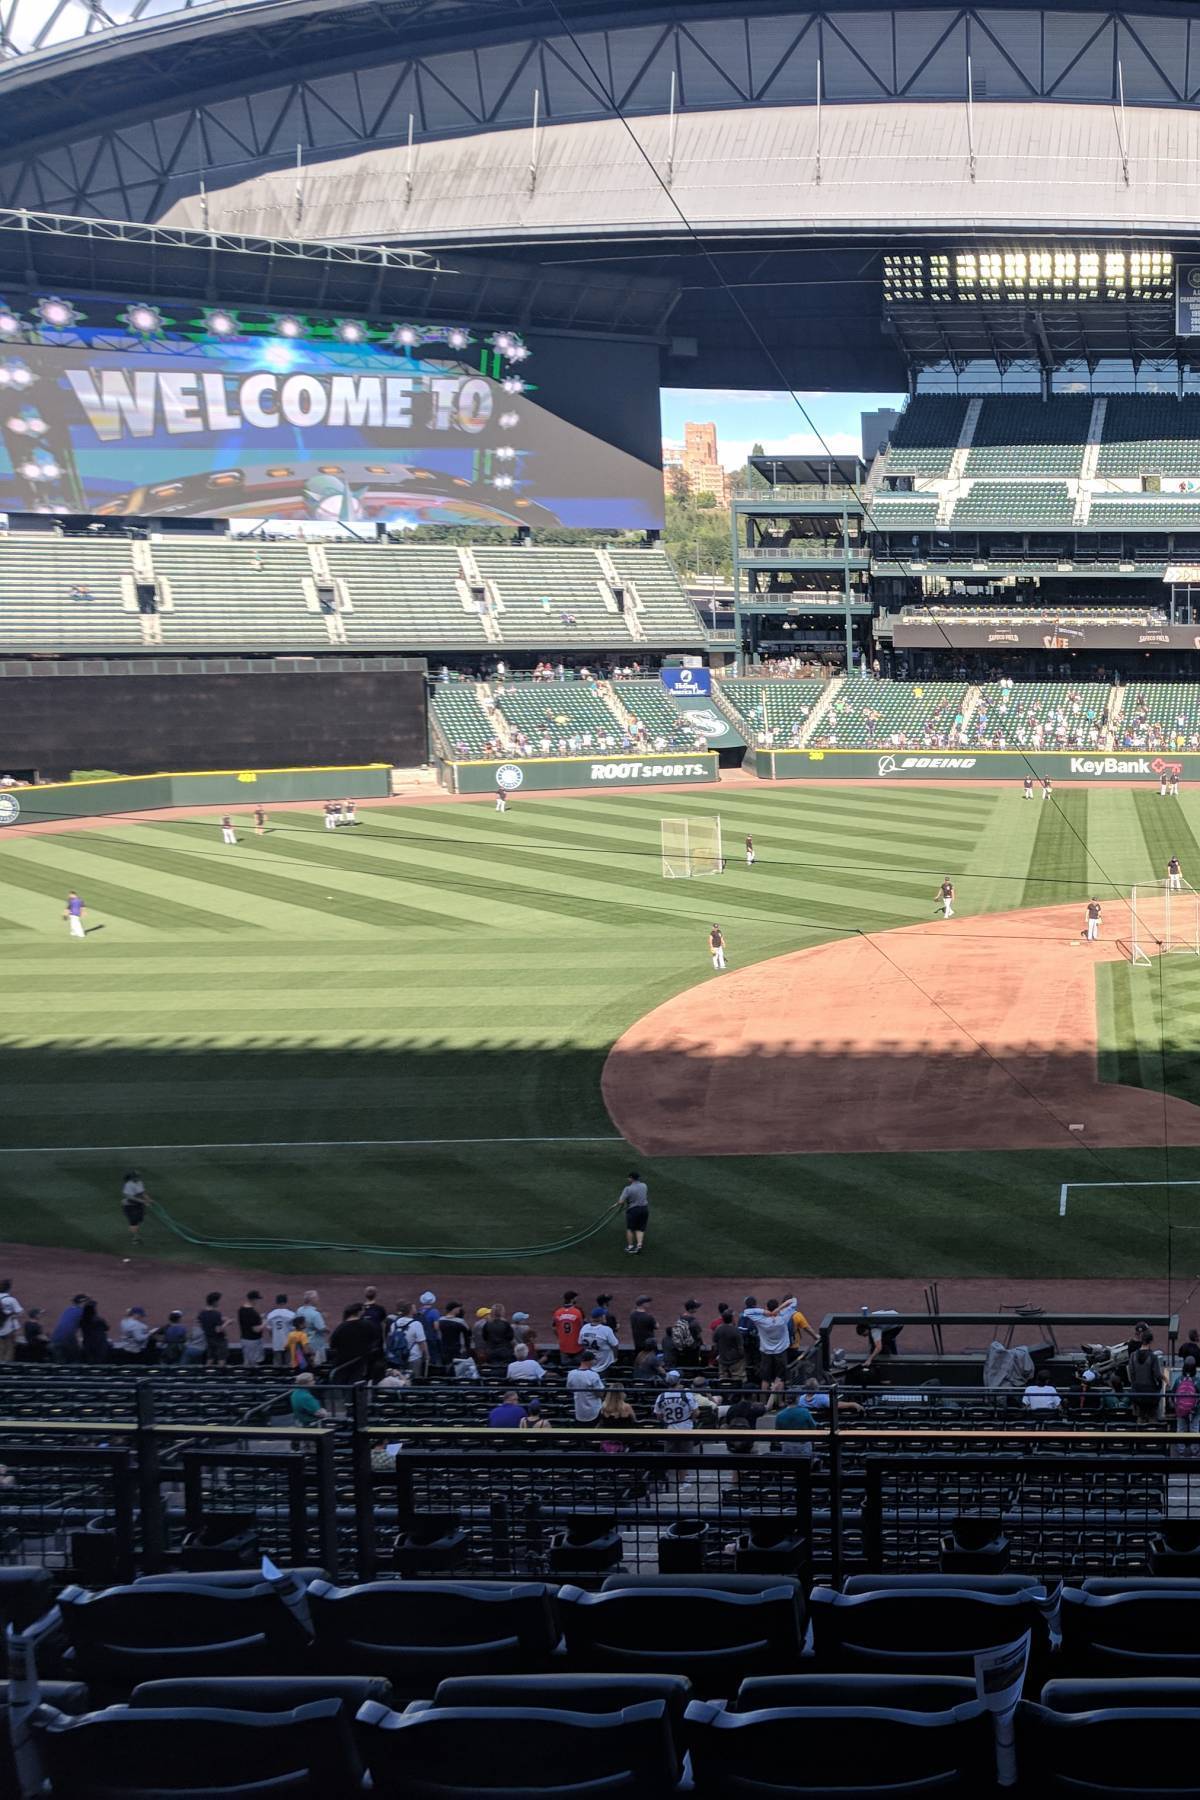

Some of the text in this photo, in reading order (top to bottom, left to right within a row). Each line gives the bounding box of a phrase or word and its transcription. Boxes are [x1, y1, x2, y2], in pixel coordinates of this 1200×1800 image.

[65, 368, 494, 441] WELCOME TO
[590, 762, 704, 779] ROOT SPORTS
[902, 758, 976, 769] BOEING
[1070, 758, 1150, 775] KeyBank
[665, 1407, 684, 1419] 28
